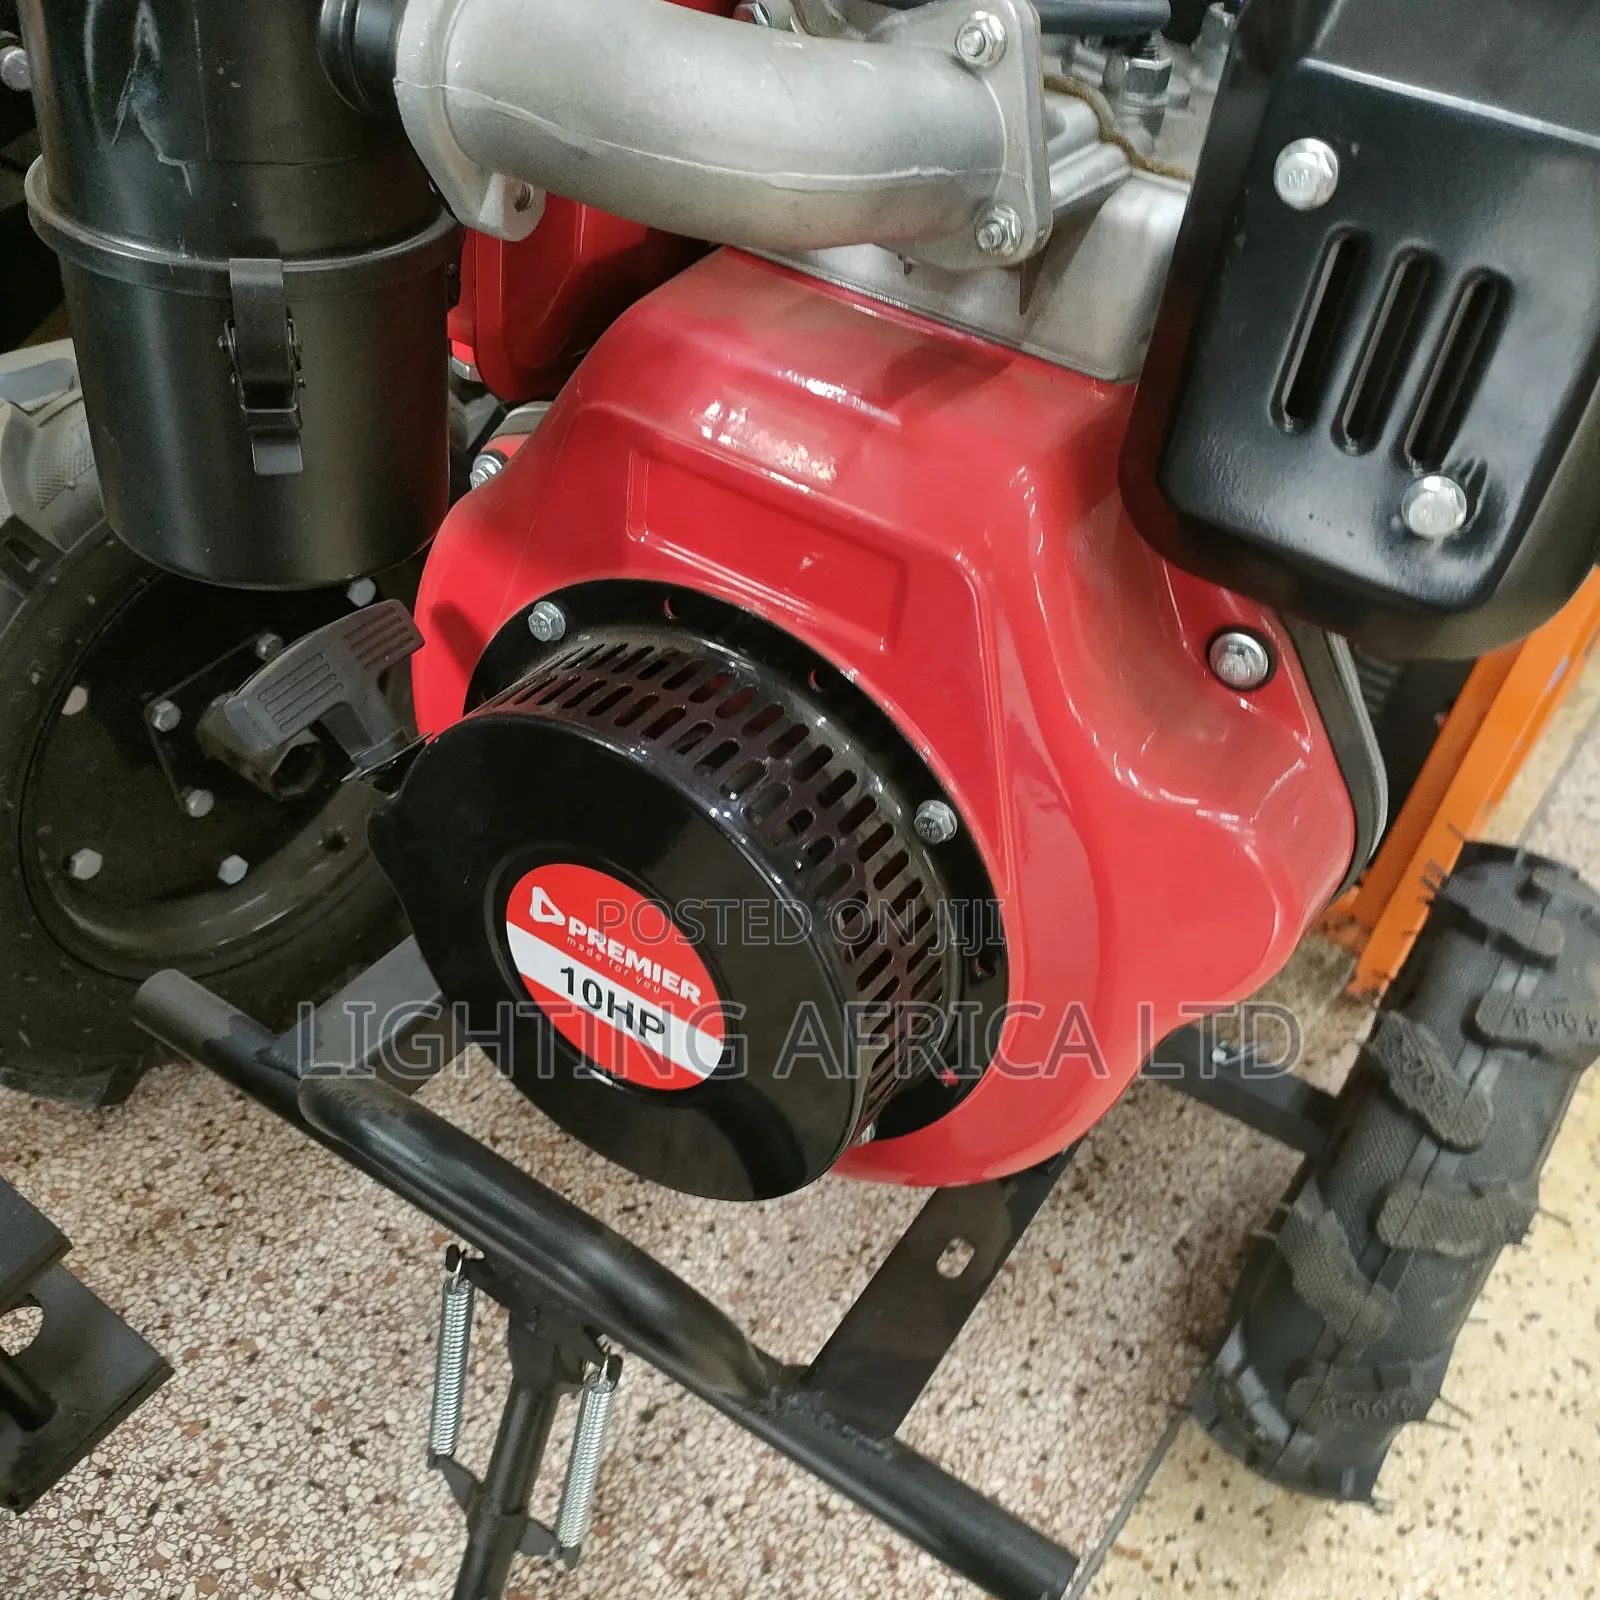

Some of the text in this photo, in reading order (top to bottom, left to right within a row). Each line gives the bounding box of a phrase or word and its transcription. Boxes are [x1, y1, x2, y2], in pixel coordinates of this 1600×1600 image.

[567, 915, 702, 1006] PREMIER
[567, 936, 661, 995] made for you
[560, 965, 666, 1038] 10HP
